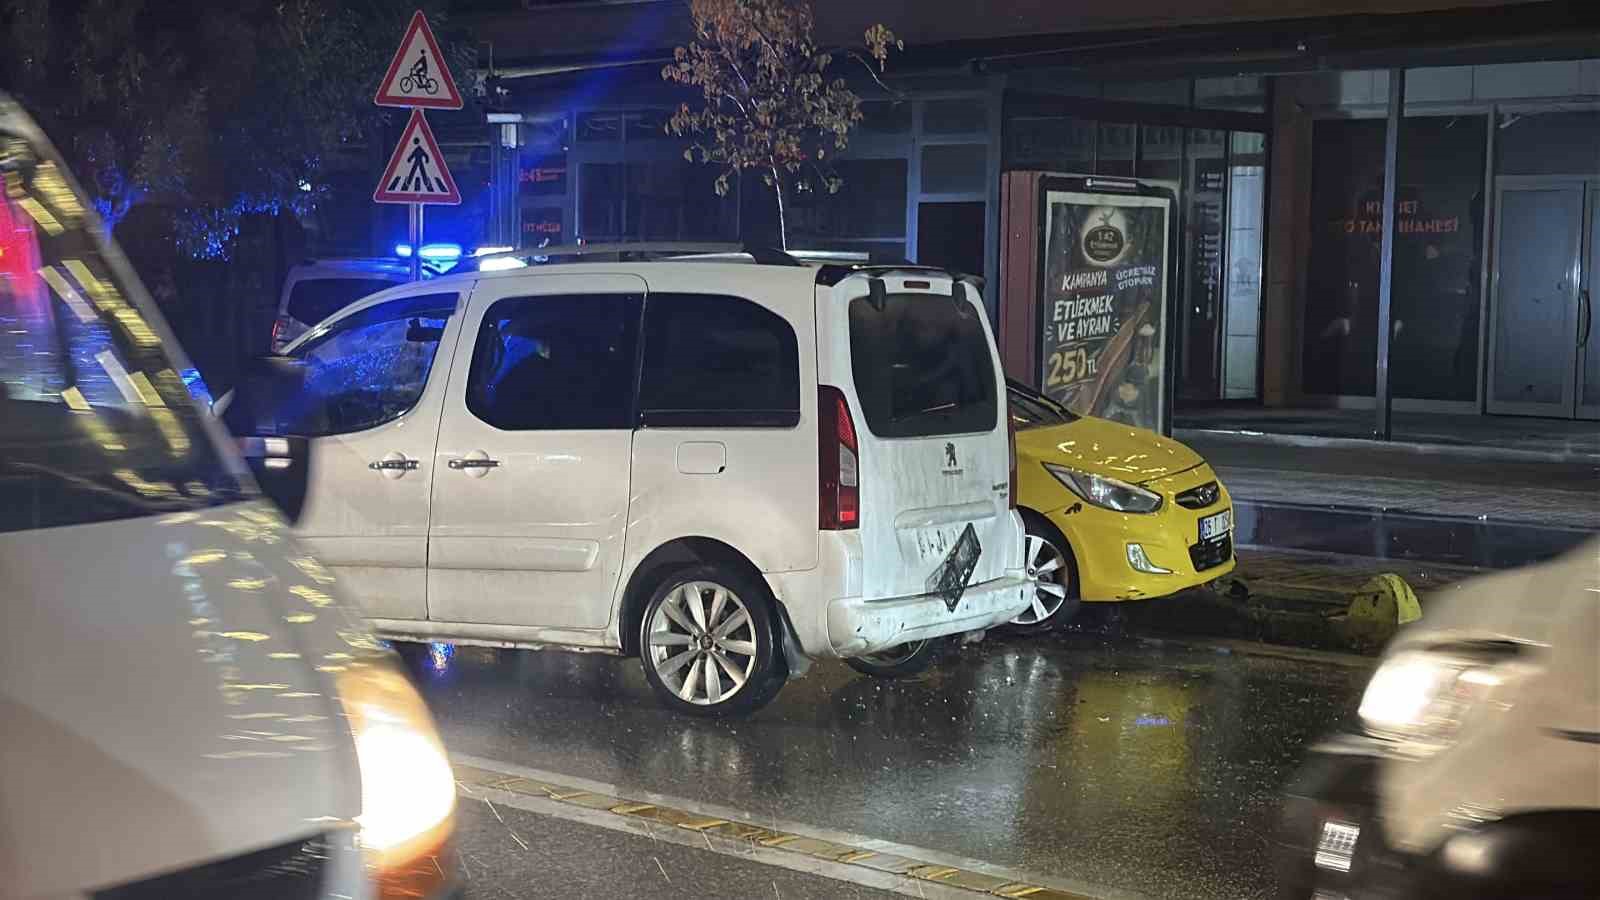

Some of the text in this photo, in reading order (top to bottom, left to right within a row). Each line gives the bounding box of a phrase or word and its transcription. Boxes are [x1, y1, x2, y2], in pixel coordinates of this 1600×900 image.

[1062, 270, 1108, 291] KAMPANYA
[1054, 294, 1114, 322] ETLİEKMEK
[1058, 315, 1110, 342] VE AYRAN
